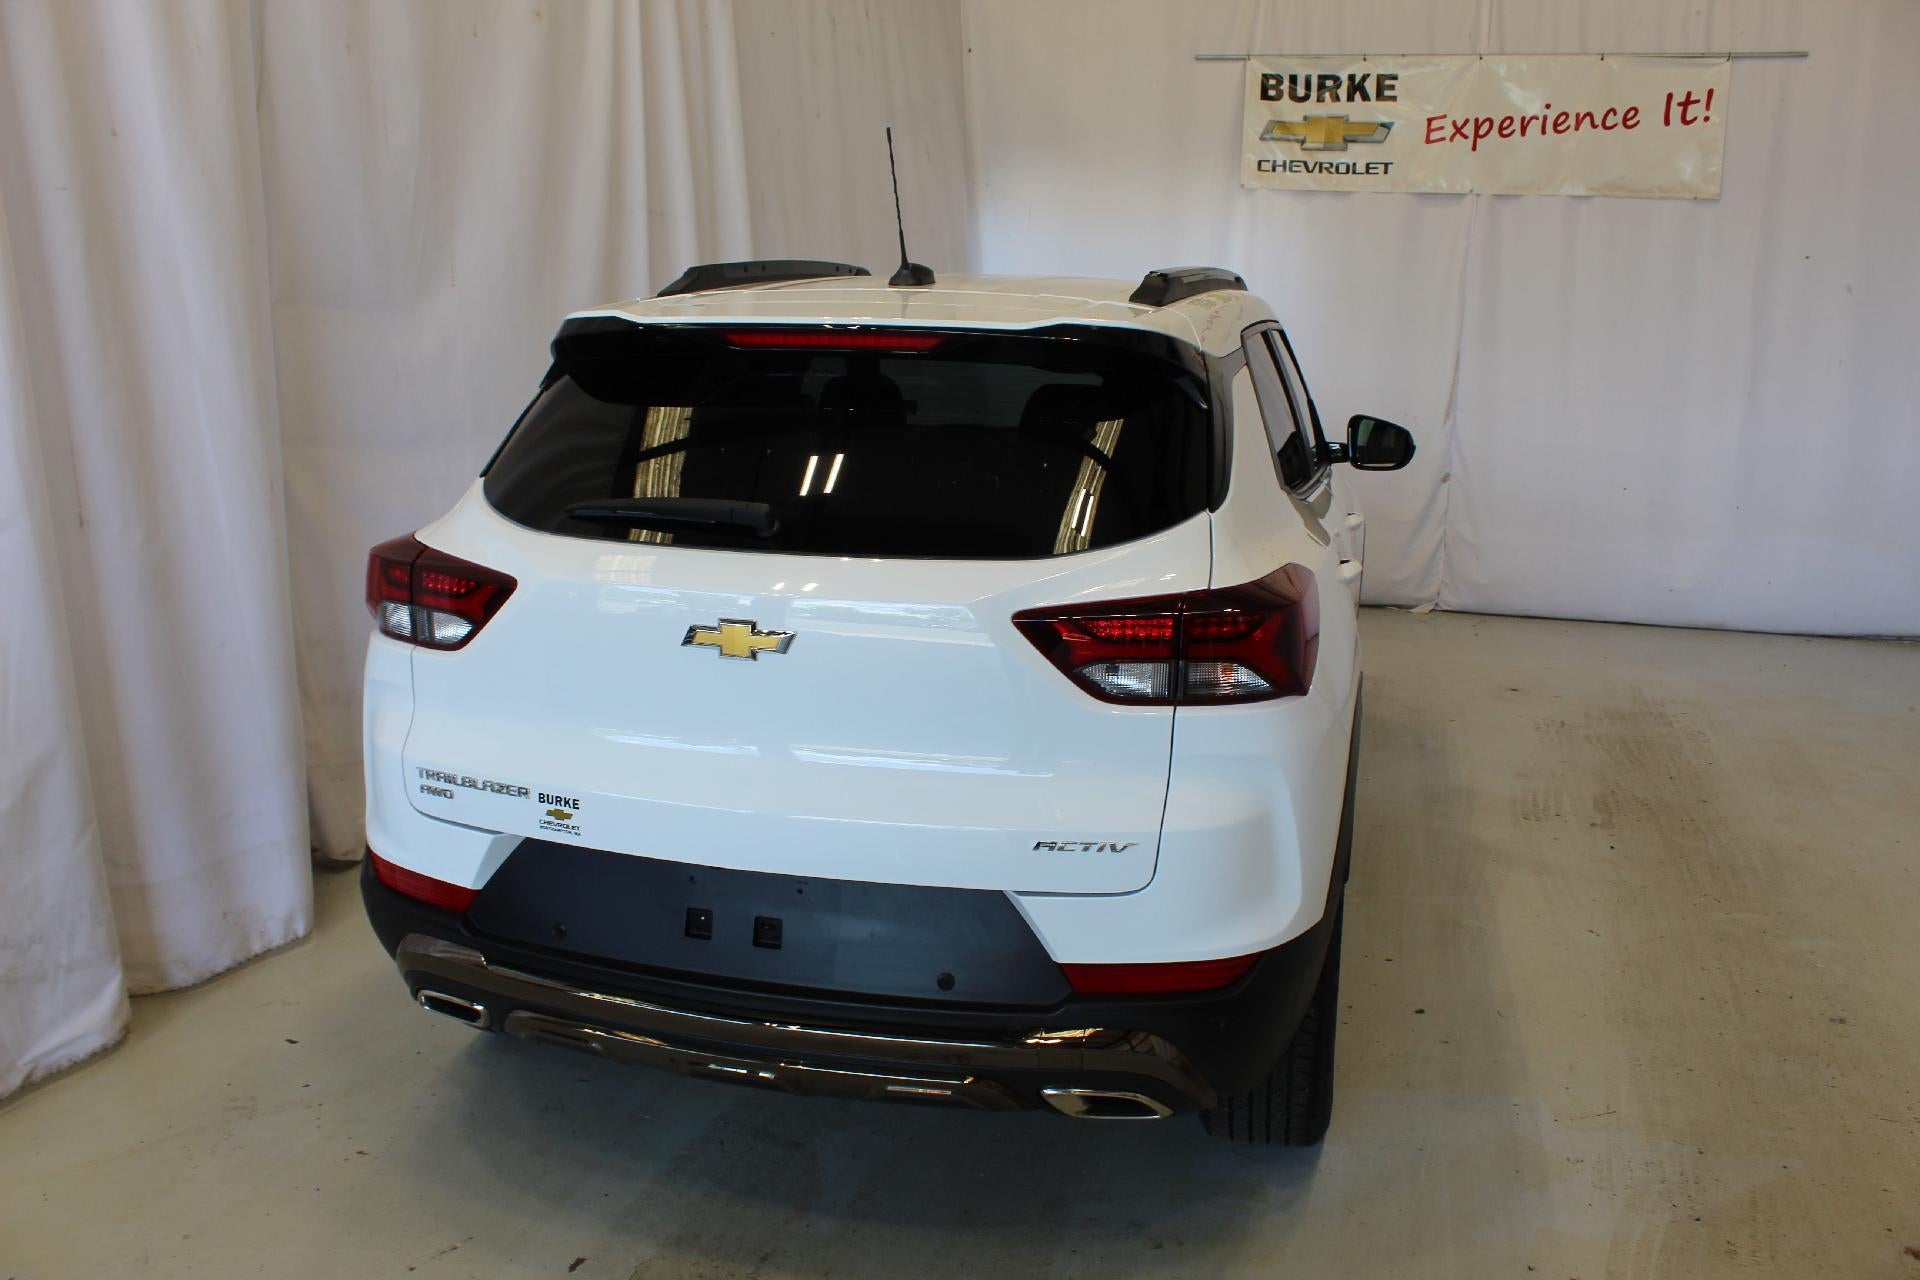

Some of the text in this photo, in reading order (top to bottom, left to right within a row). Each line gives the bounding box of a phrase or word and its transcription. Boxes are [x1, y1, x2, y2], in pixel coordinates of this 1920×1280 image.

[1260, 72, 1398, 103] BURKE
[1424, 88, 1715, 151] Experience It!
[1257, 158, 1394, 176] CHEVROLET
[416, 767, 531, 799] TRAILBLAZER
[538, 793, 580, 810] BURKE
[538, 819, 581, 831] CHEVROLET
[1032, 840, 1139, 853] ACTIV
